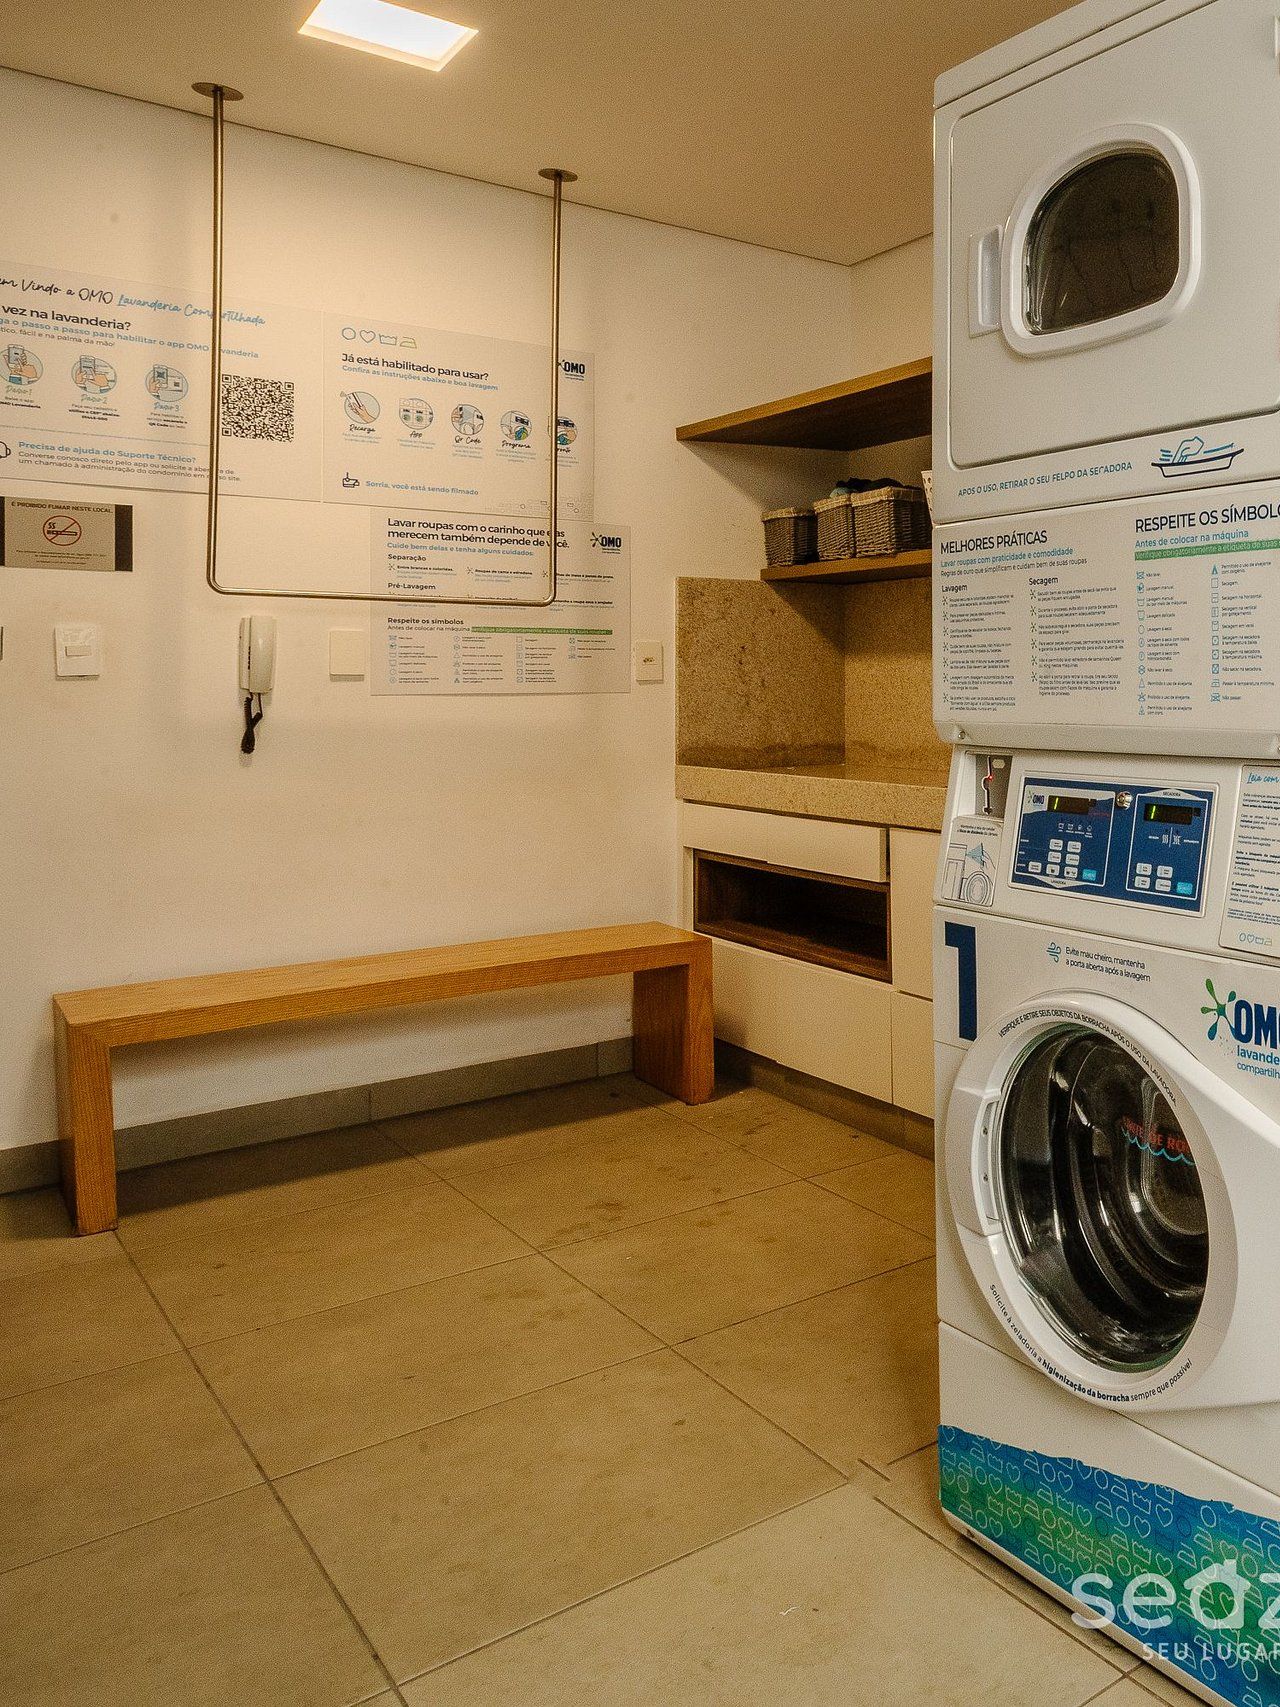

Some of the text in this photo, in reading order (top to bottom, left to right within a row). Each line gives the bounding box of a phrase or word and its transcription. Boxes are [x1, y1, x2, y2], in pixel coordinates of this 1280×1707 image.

[21, 279, 61, 296] Vindo
[79, 288, 113, 305] OMO
[1, 305, 131, 330] vez na lavanderia?
[341, 353, 488, 380] Já está habilitado para usar?
[562, 359, 585, 374] OMO
[18, 441, 55, 450] Precisa
[72, 446, 100, 454] ajuda
[116, 450, 155, 459] Suporte
[156, 453, 196, 463] Técnico?
[958, 486, 975, 496] APOS
[976, 485, 982, 493] O
[982, 482, 998, 492] USO,
[999, 478, 1028, 490] RETIRAR
[1028, 476, 1035, 485] O
[1036, 474, 1050, 484] SEU
[1051, 470, 1075, 482] FELPO
[1076, 468, 1088, 477] DA
[387, 517, 416, 527] Lavar
[417, 521, 454, 531] roupas
[488, 524, 525, 536] carinho
[527, 528, 545, 537] que
[1135, 512, 1195, 532] RESPEITE
[1198, 509, 1218, 525] OS
[387, 530, 438, 540] merecem
[440, 532, 485, 543] também
[486, 535, 531, 546] depende
[532, 537, 545, 546] de
[600, 536, 621, 548] OMO
[940, 529, 1047, 554] MELHORES PRÁTICAS
[387, 553, 426, 562] Separação
[387, 581, 436, 590] Pré-Lavagem
[941, 584, 967, 593] Lavagem
[1028, 576, 1058, 586] Secagem
[944, 921, 977, 1042] 1
